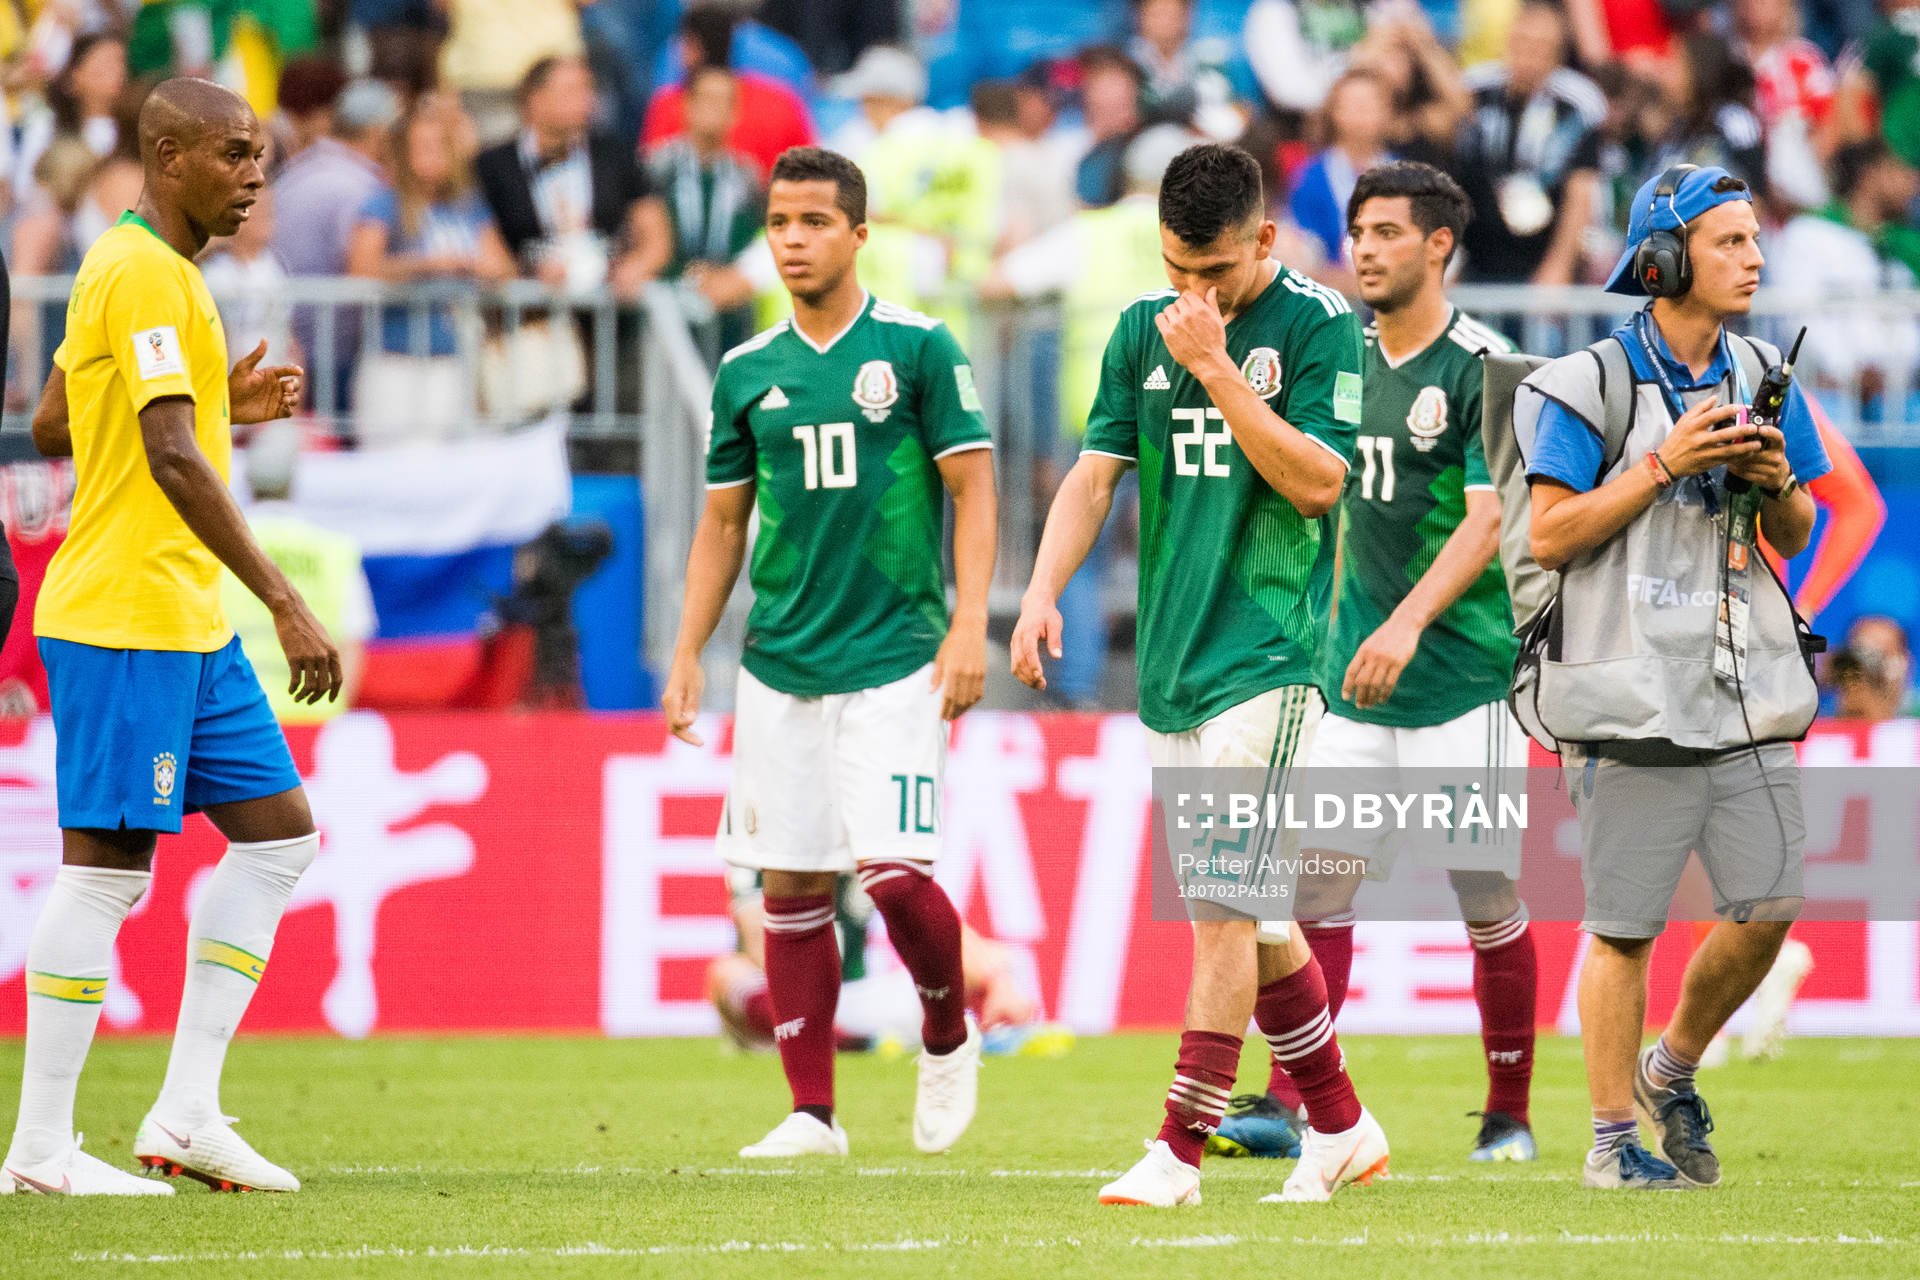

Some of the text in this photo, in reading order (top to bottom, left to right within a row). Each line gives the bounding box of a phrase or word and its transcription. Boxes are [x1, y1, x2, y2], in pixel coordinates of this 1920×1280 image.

[792, 422, 857, 490] 10
[1172, 407, 1232, 477] 22
[1357, 435, 1395, 502] 11
[891, 774, 935, 834] 10
